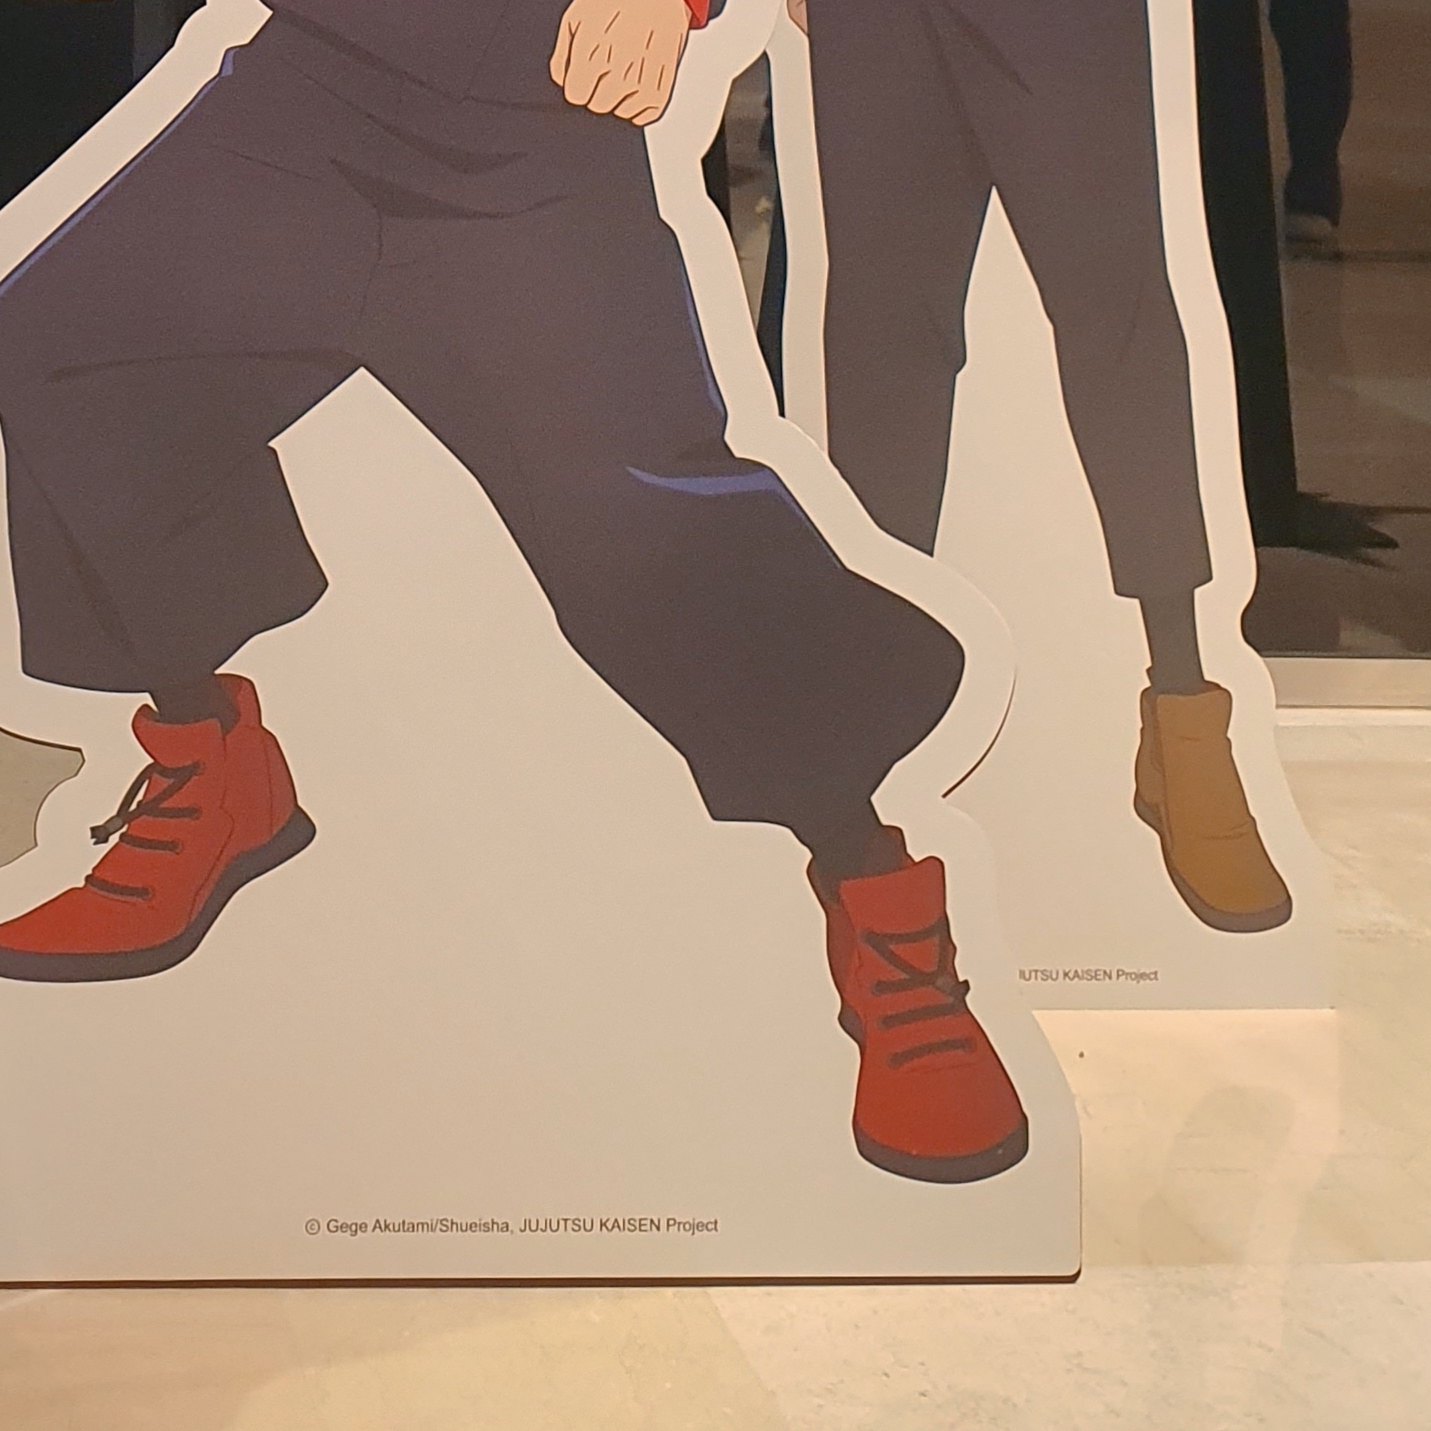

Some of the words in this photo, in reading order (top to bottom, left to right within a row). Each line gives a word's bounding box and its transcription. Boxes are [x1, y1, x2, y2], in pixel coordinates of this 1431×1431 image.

[1063, 968, 1113, 982] KAISEN
[1116, 968, 1159, 984] Project
[326, 1218, 368, 1236] Gege
[371, 1218, 515, 1235] Akutami/Shueisha,
[519, 1217, 595, 1234] JUJUTSU
[598, 1217, 662, 1234] KAISEN
[666, 1217, 719, 1236] Project
